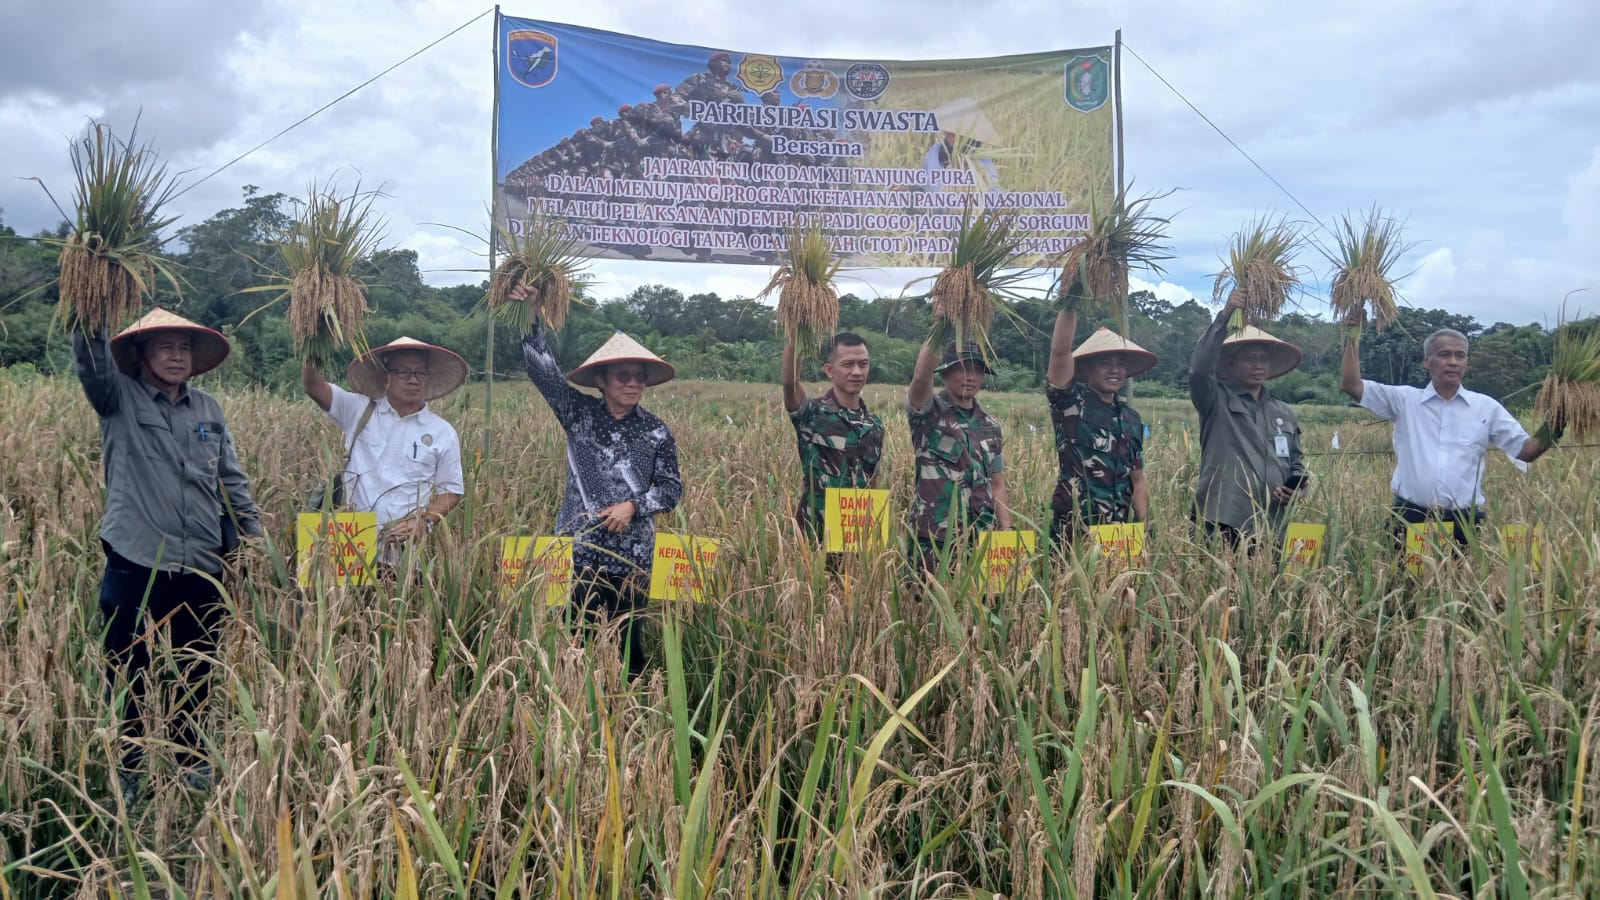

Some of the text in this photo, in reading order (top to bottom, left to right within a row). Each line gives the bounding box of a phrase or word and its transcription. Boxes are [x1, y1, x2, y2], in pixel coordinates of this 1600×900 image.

[690, 101, 939, 132] PARTISIPASI SWASTA
[773, 136, 862, 157] Bersama
[643, 157, 715, 177] JAJARAN
[718, 162, 750, 179] TNI
[762, 165, 823, 182] KODAM
[827, 167, 851, 184] XII
[855, 168, 927, 186] TANJUNG
[931, 169, 975, 185] PURA
[549, 175, 1066, 208] DALAM MENUNJANG PROGRAM KETAHANAN PANGAN NASIONAL
[609, 202, 735, 227] PELAKSANAAN
[823, 212, 862, 230] PADI
[864, 214, 911, 231] GOGO
[1018, 214, 1090, 231] SORGUM
[589, 224, 690, 248] TEKNOLOGI
[693, 229, 747, 249] TANPA
[870, 238, 902, 253] TOT
[658, 546, 692, 560] KEPAL
